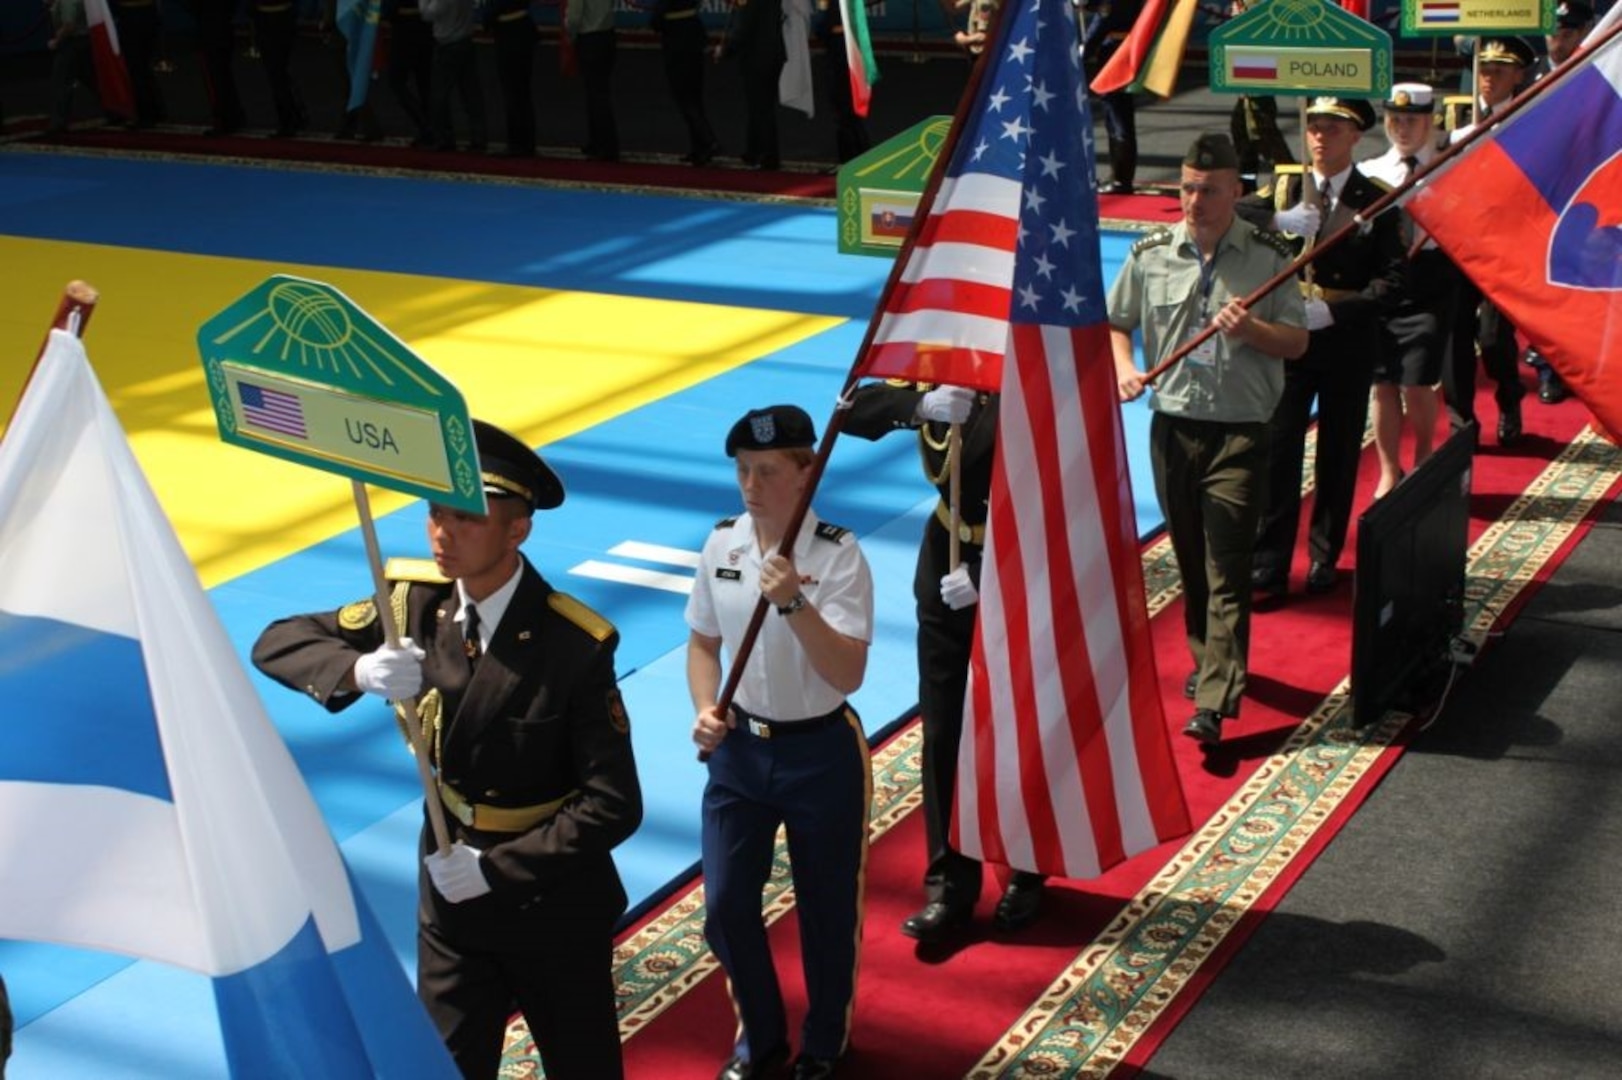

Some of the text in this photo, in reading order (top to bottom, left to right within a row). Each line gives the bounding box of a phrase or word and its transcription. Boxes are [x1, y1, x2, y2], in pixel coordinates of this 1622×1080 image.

[1466, 9, 1531, 18] NETHERLANDS
[1289, 61, 1358, 77] POLAND
[344, 417, 399, 455] USA
